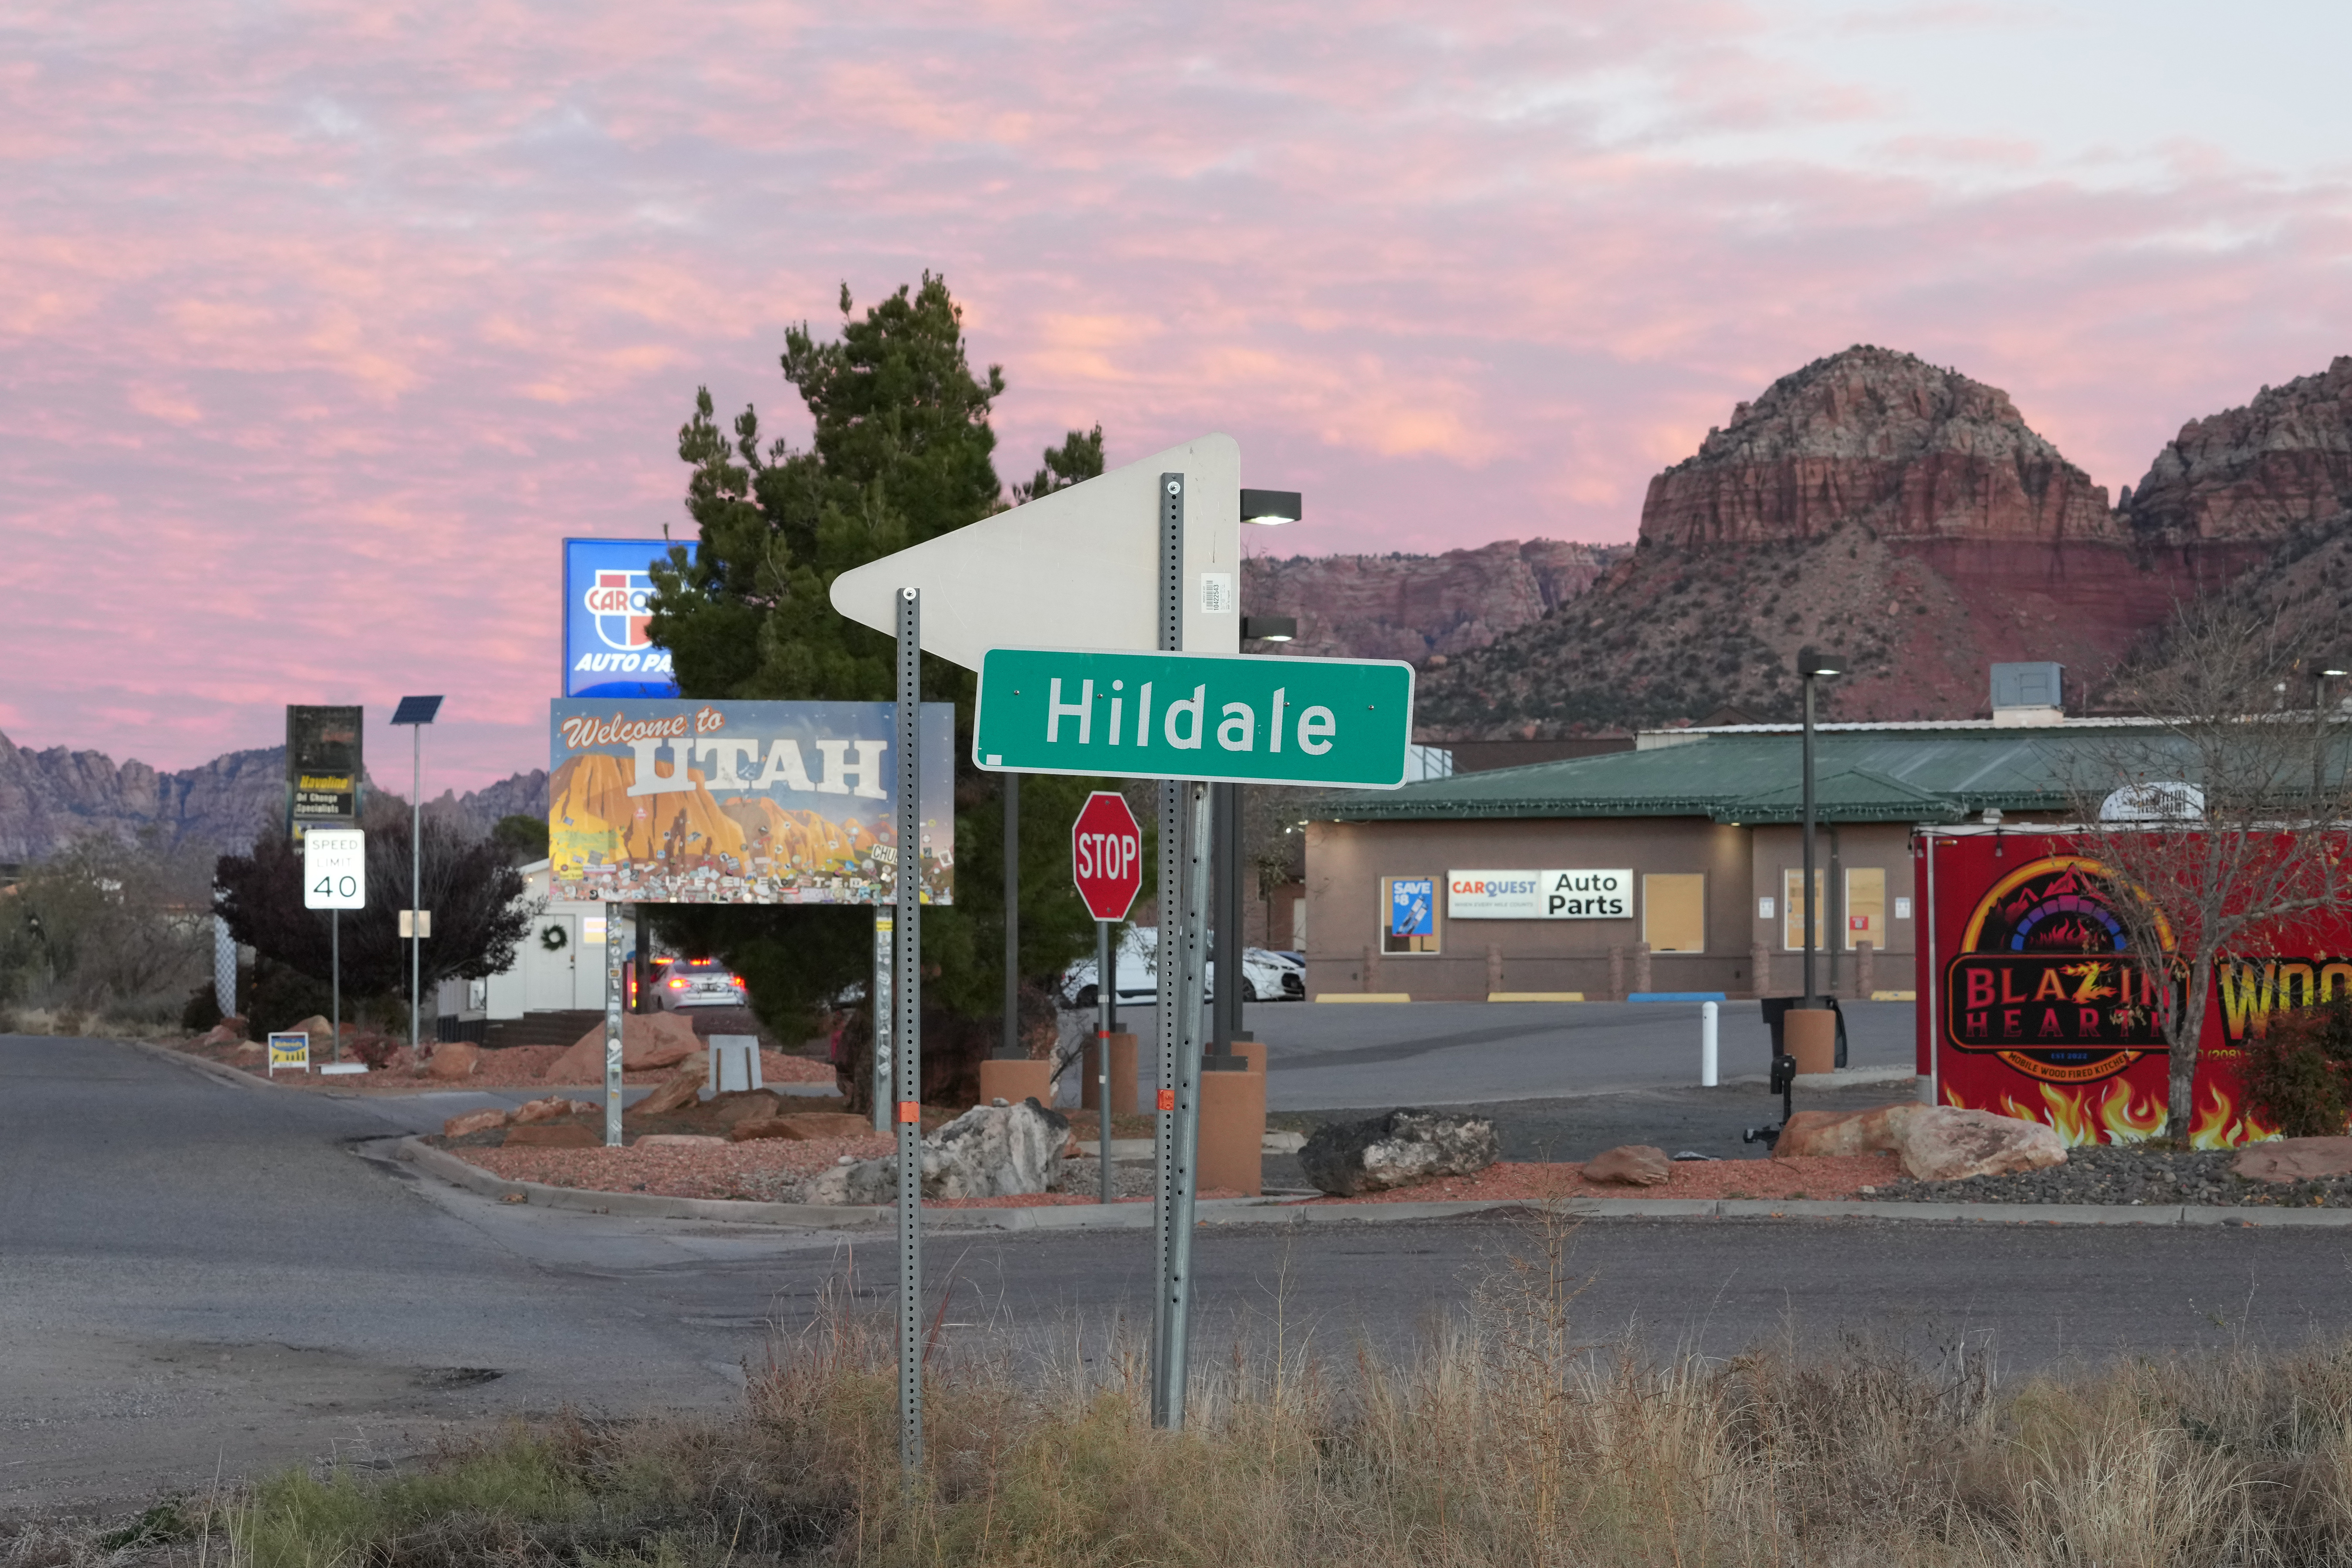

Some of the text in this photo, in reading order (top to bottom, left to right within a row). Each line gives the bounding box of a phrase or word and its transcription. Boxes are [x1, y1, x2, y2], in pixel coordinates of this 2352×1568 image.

[589, 590, 653, 613] CARQ
[574, 653, 674, 672] AUTO PA
[1047, 678, 1336, 755] Hildale
[561, 706, 724, 749] Welcome to
[627, 737, 888, 800] UTAH
[300, 775, 348, 789] Havoline
[296, 793, 338, 804] Oil Change
[297, 804, 339, 813] Specialists
[313, 840, 357, 850] SPEED
[317, 858, 351, 867] LIMIT
[1079, 832, 1136, 880] STOP
[314, 876, 356, 897] 40
[649, 875, 863, 888] IFE ELETED
[1394, 882, 1431, 894] SAVE
[1453, 881, 1536, 896] CARQUEST
[1555, 874, 1617, 892] Auto
[1394, 894, 1409, 906] $8
[1549, 895, 1622, 915] Parts
[1965, 960, 2171, 1010] BLAZIN
[1965, 1008, 2170, 1037] HEARTH
[2207, 1049, 2242, 1061] (208)
[2008, 1052, 2039, 1072] MOBILE
[2041, 1066, 2066, 1078] WOOD
[2068, 1068, 2093, 1078] FIRED
